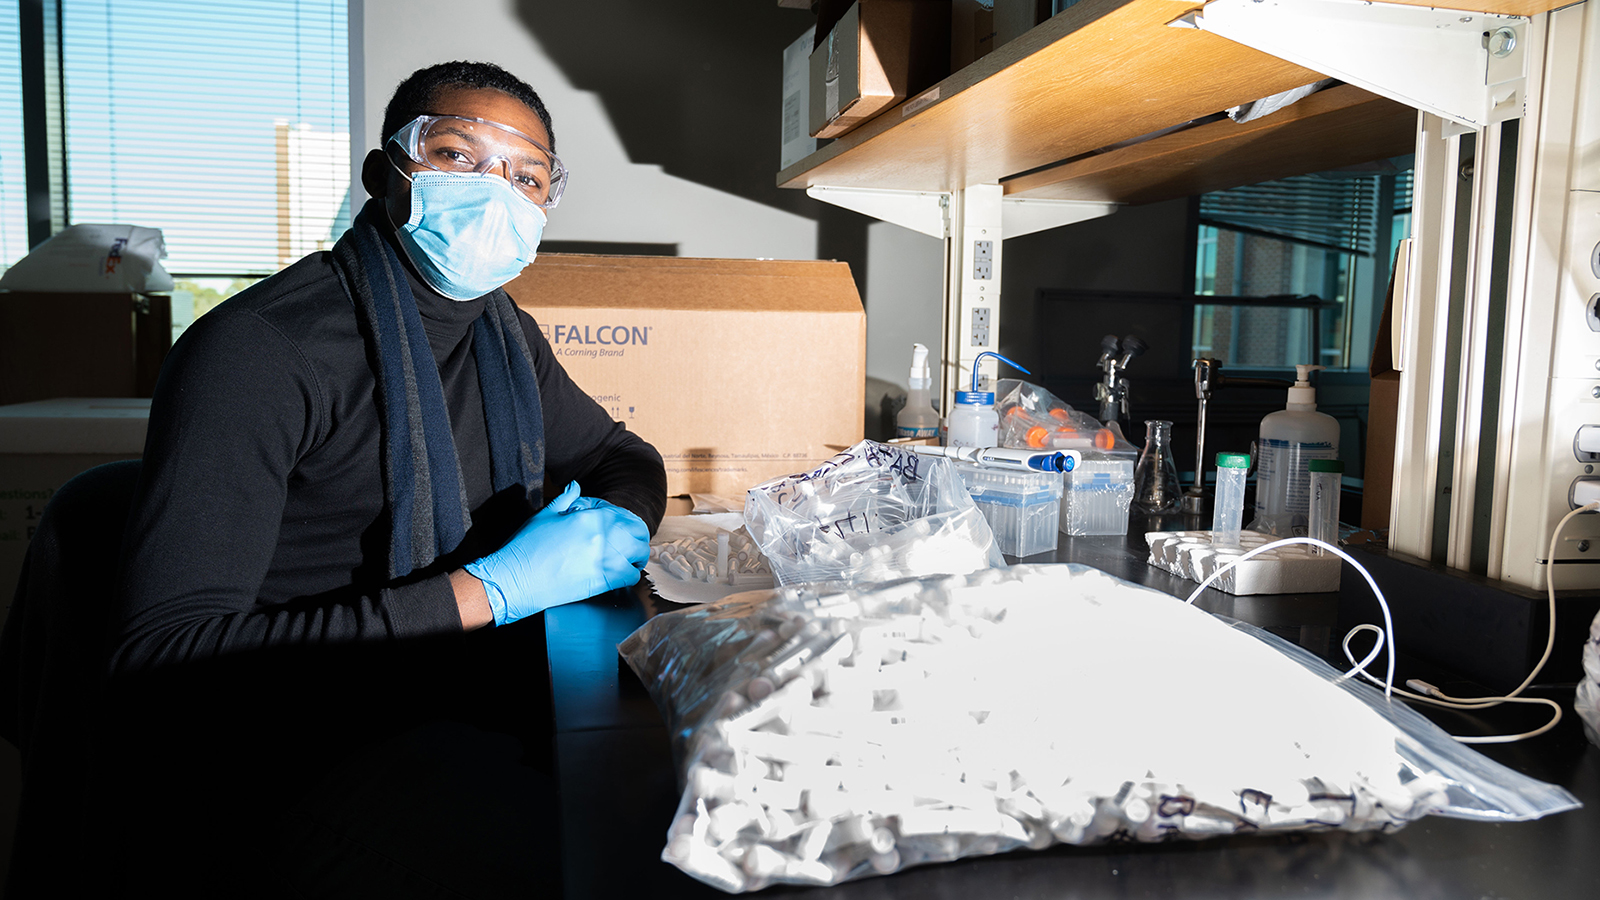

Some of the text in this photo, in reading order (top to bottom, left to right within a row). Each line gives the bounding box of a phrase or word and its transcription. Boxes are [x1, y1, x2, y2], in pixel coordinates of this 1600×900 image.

[106, 238, 128, 274] FedEx
[555, 325, 648, 345] FALCON
[556, 348, 624, 359] A Corning Brand
[915, 428, 936, 438] AWAY
